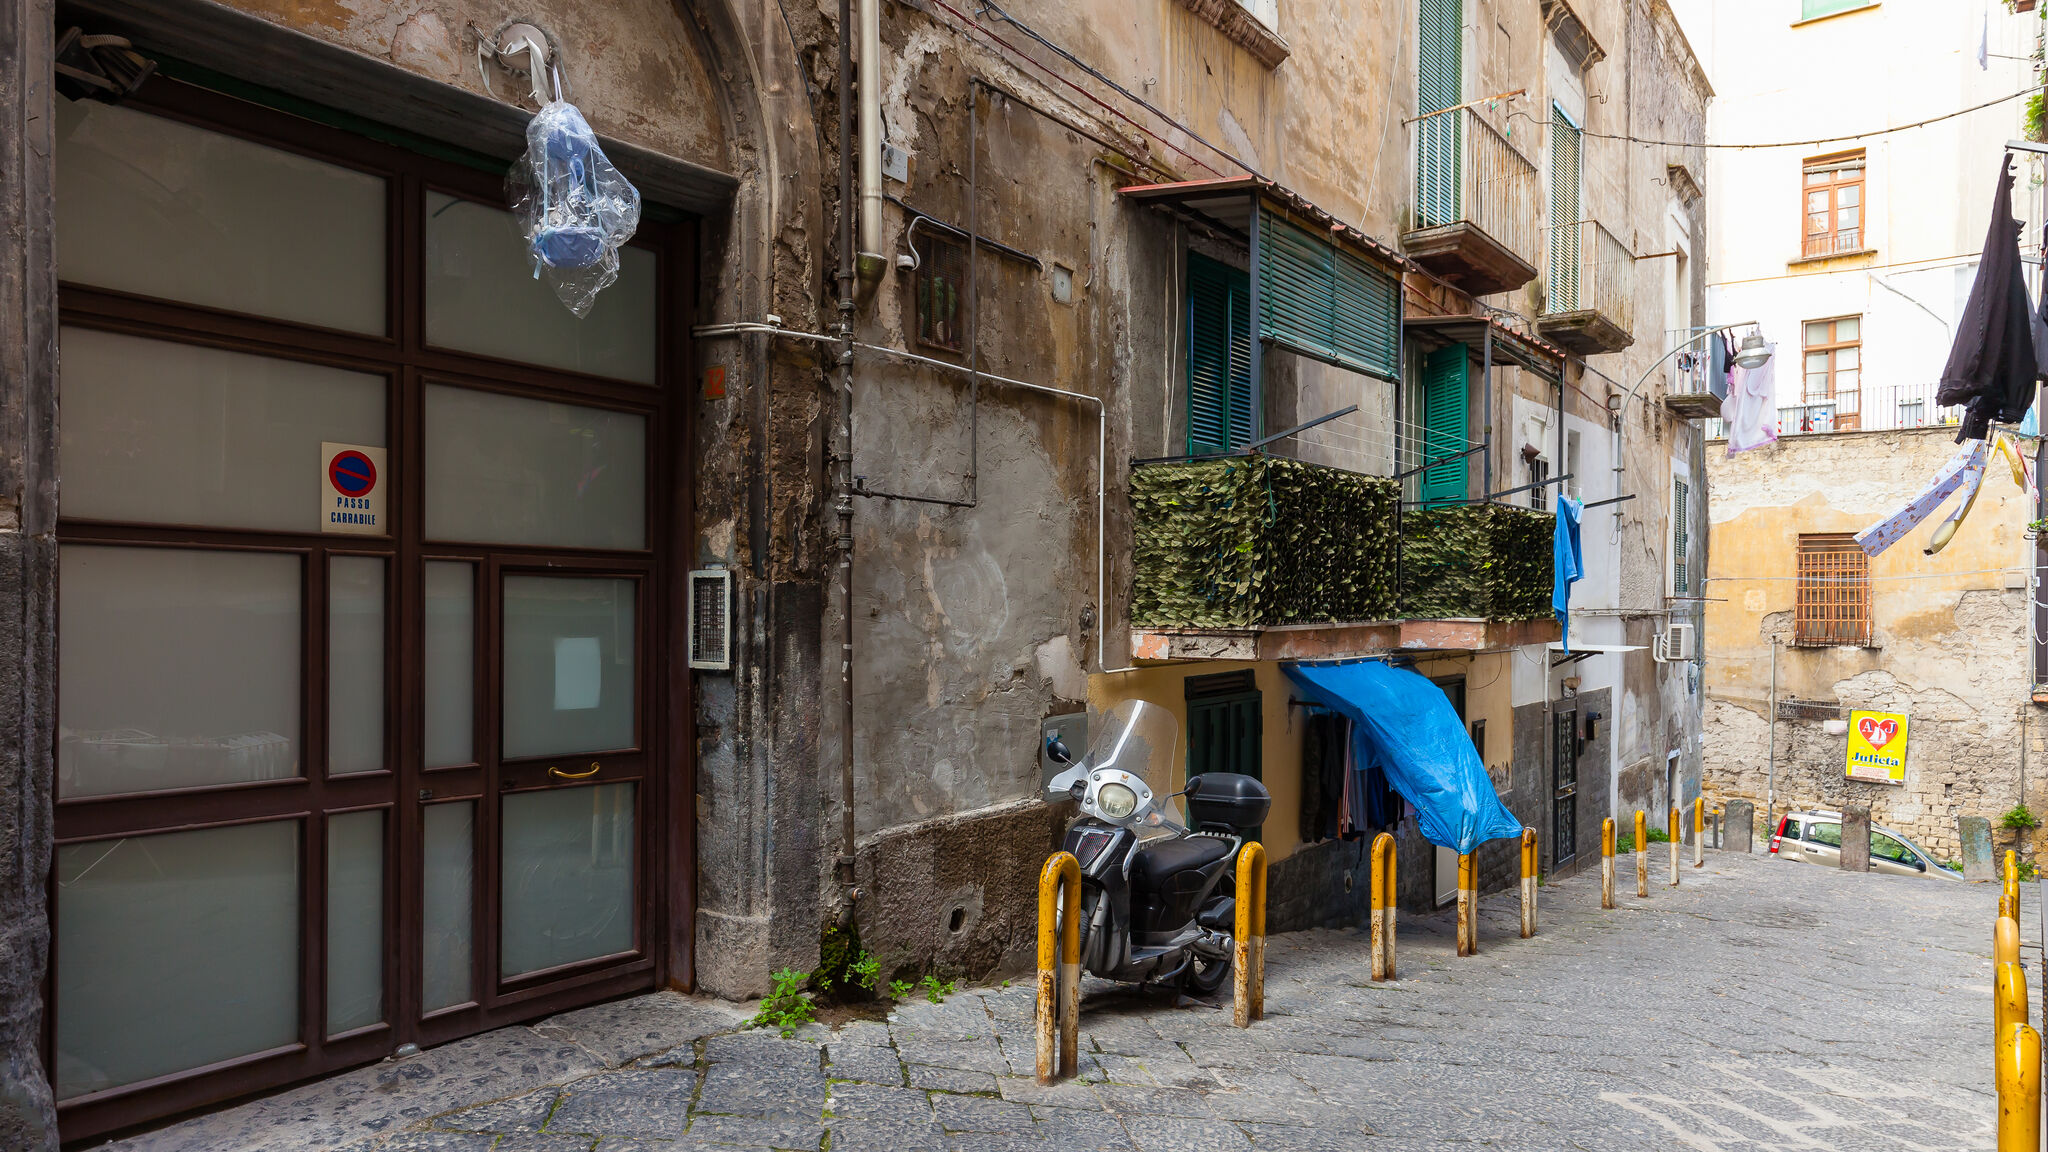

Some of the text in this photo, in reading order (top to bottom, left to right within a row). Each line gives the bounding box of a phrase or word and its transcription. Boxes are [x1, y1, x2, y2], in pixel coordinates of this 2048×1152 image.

[337, 497, 370, 510] PASSO
[331, 512, 376, 526] CARRABILE
[1862, 721, 1896, 734] A J
[1851, 752, 1900, 766] Julieta
